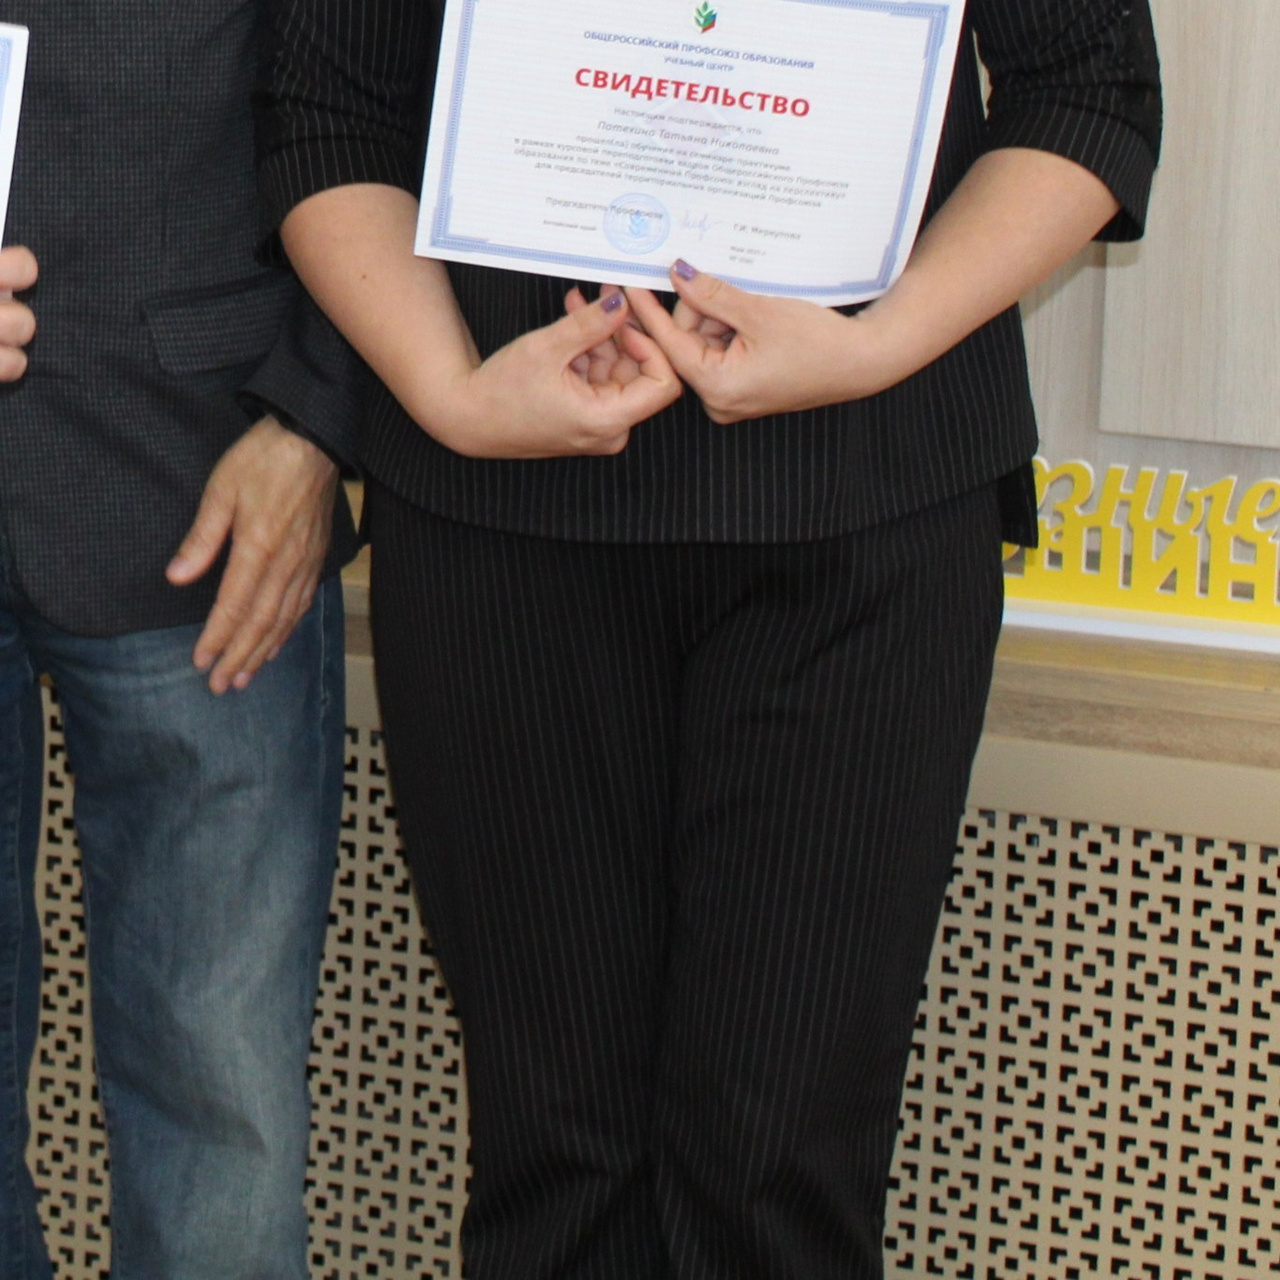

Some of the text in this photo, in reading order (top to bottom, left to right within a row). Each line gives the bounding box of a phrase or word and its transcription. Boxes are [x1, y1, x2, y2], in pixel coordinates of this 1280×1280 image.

[583, 30, 815, 69] ОБЩЕРОССИЙСКИЙ ПРОФСОЮЗ ОБРАЗОВАНИЯ
[706, 62, 734, 72] ЦЕНТР
[573, 67, 811, 118] СВИДЕТЕЛЬСТВО
